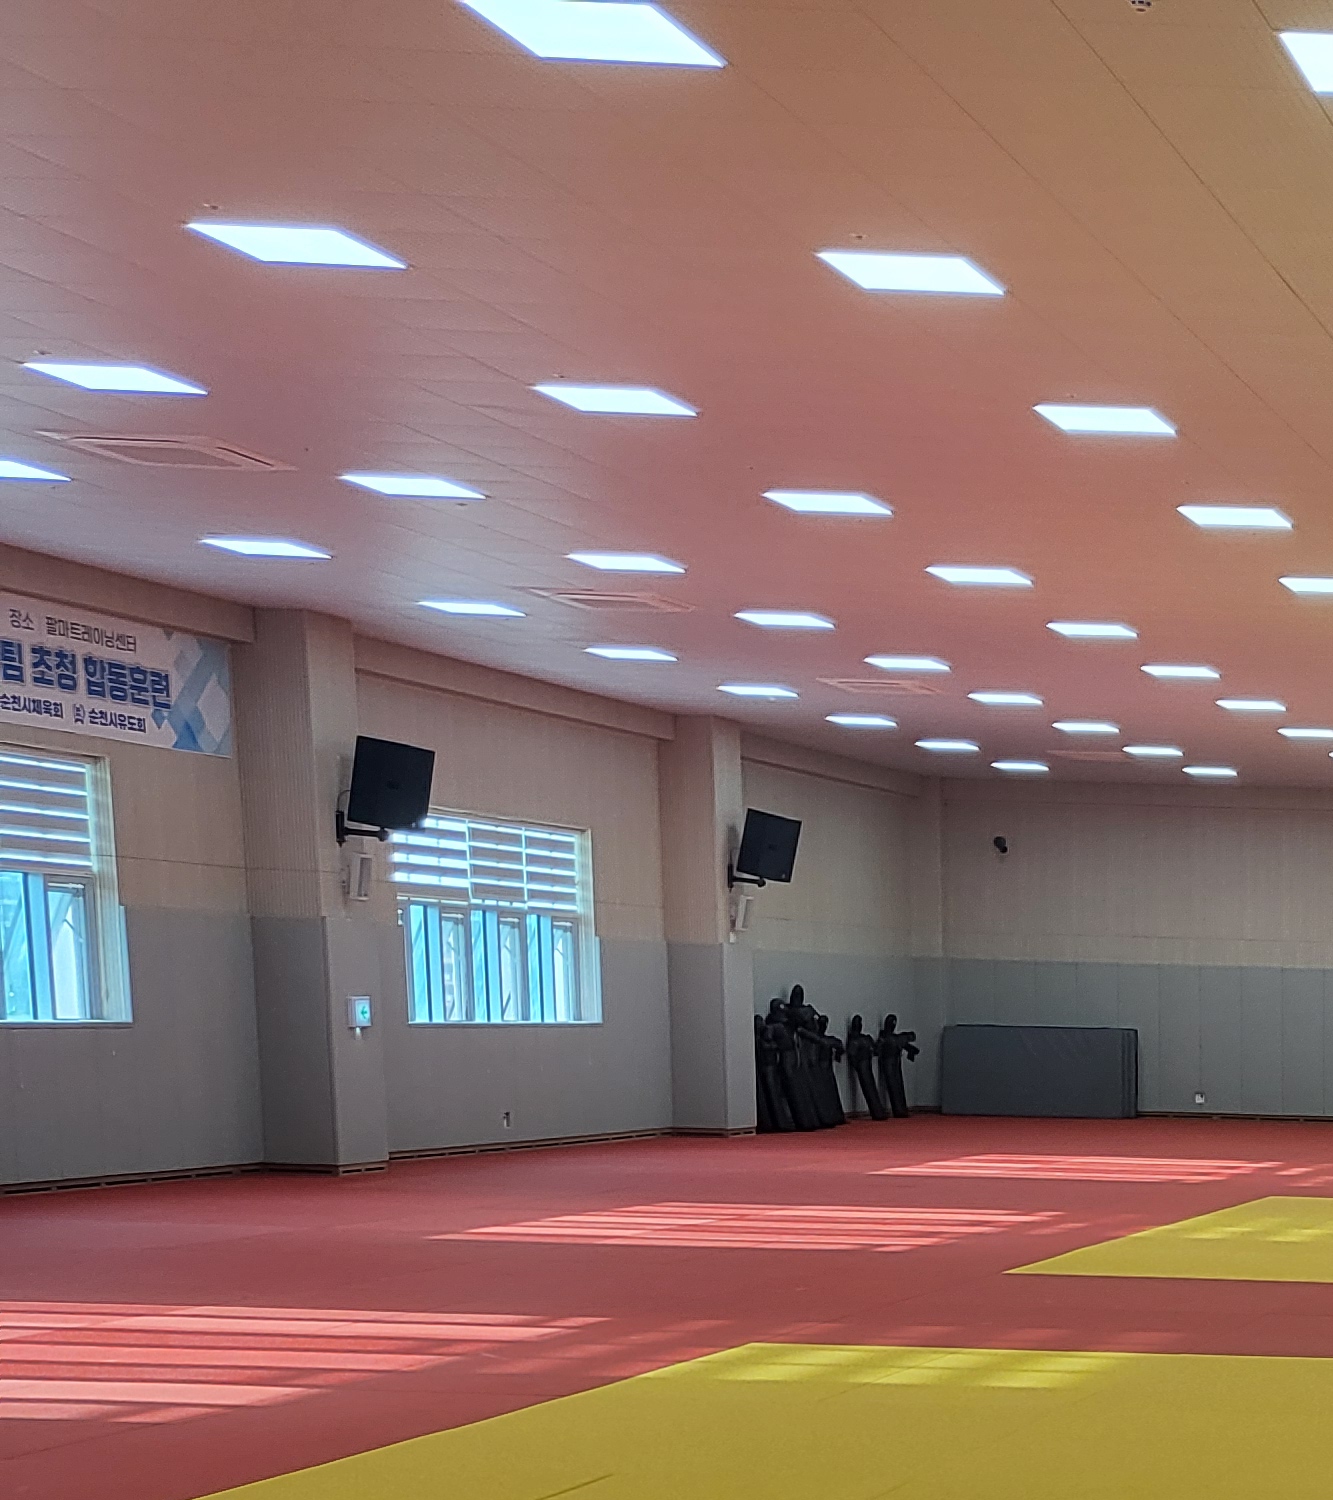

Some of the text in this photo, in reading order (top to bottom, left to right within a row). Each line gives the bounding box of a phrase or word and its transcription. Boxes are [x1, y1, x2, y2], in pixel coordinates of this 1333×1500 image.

[9, 608, 137, 653] 장소 팔마트레이닝센터
[31, 645, 77, 692] 초청
[83, 654, 171, 709] 합동훈련
[0, 693, 64, 718] 순천시체육회
[88, 707, 146, 733] 순천시유도회
